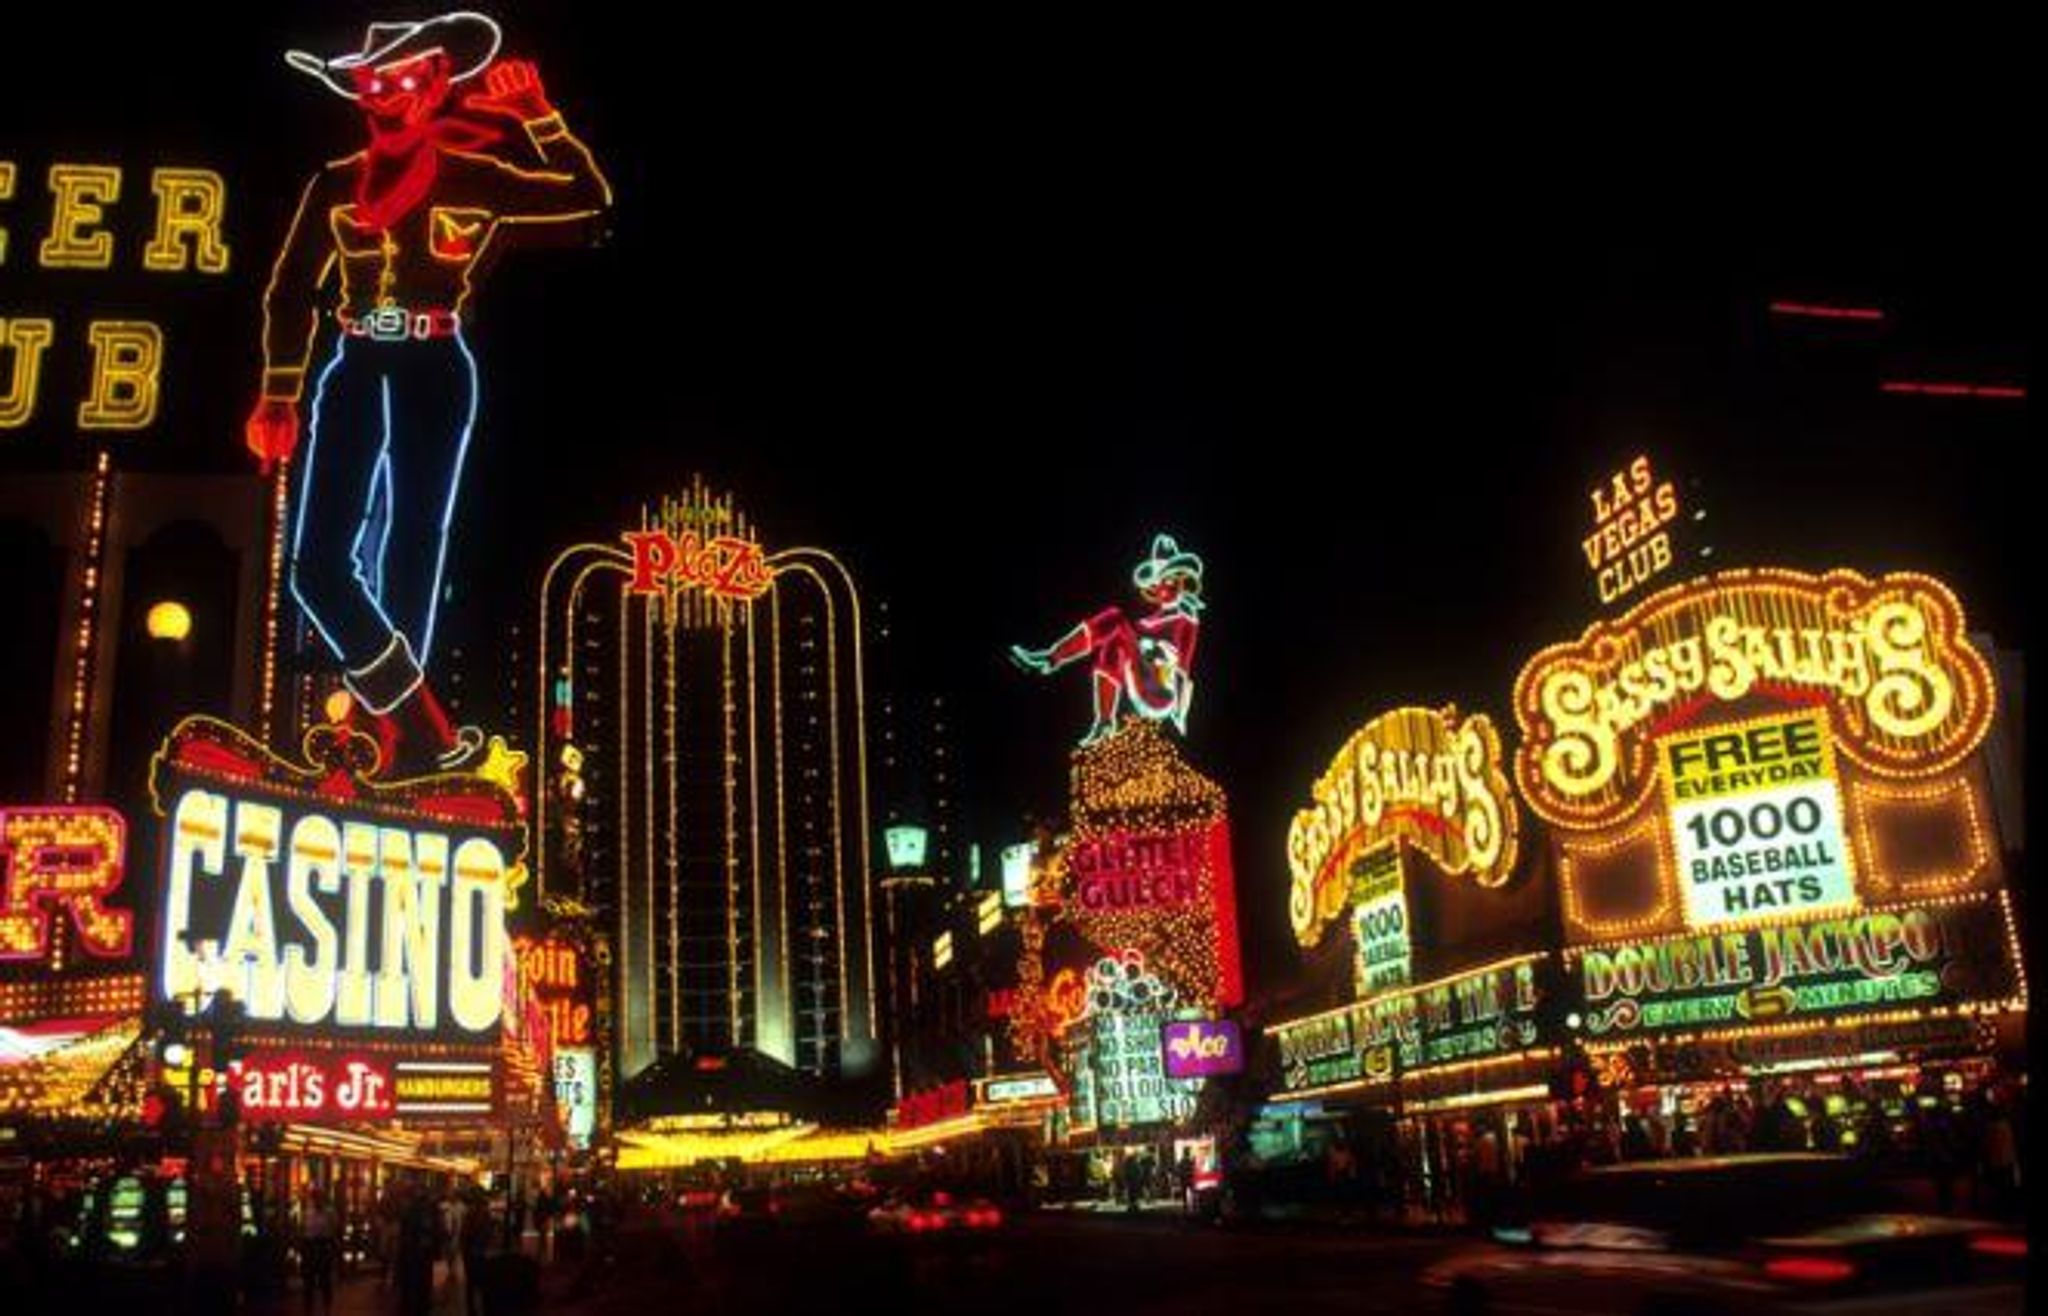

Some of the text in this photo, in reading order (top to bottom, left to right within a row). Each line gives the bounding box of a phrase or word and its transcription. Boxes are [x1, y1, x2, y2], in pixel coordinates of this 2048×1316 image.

[1590, 455, 1650, 523] LAS
[1582, 482, 1677, 570] VEGAS
[1597, 532, 1673, 603] CLUB
[1668, 718, 1821, 777] FREE
[1674, 756, 1823, 799] EVERYDAY
[1686, 796, 1821, 850] 1000
[1691, 840, 1834, 884] BASEBALL
[163, 788, 505, 1033] CASINO
[1723, 879, 1823, 914] HATS
[1583, 911, 1942, 999] DOUBLE JACKPO
[1640, 999, 1737, 1027] EVERY
[1796, 971, 1941, 1010] MINUTES
[215, 1060, 390, 1108] arl's Jr.
[397, 1076, 492, 1097] HAMBURGERS
